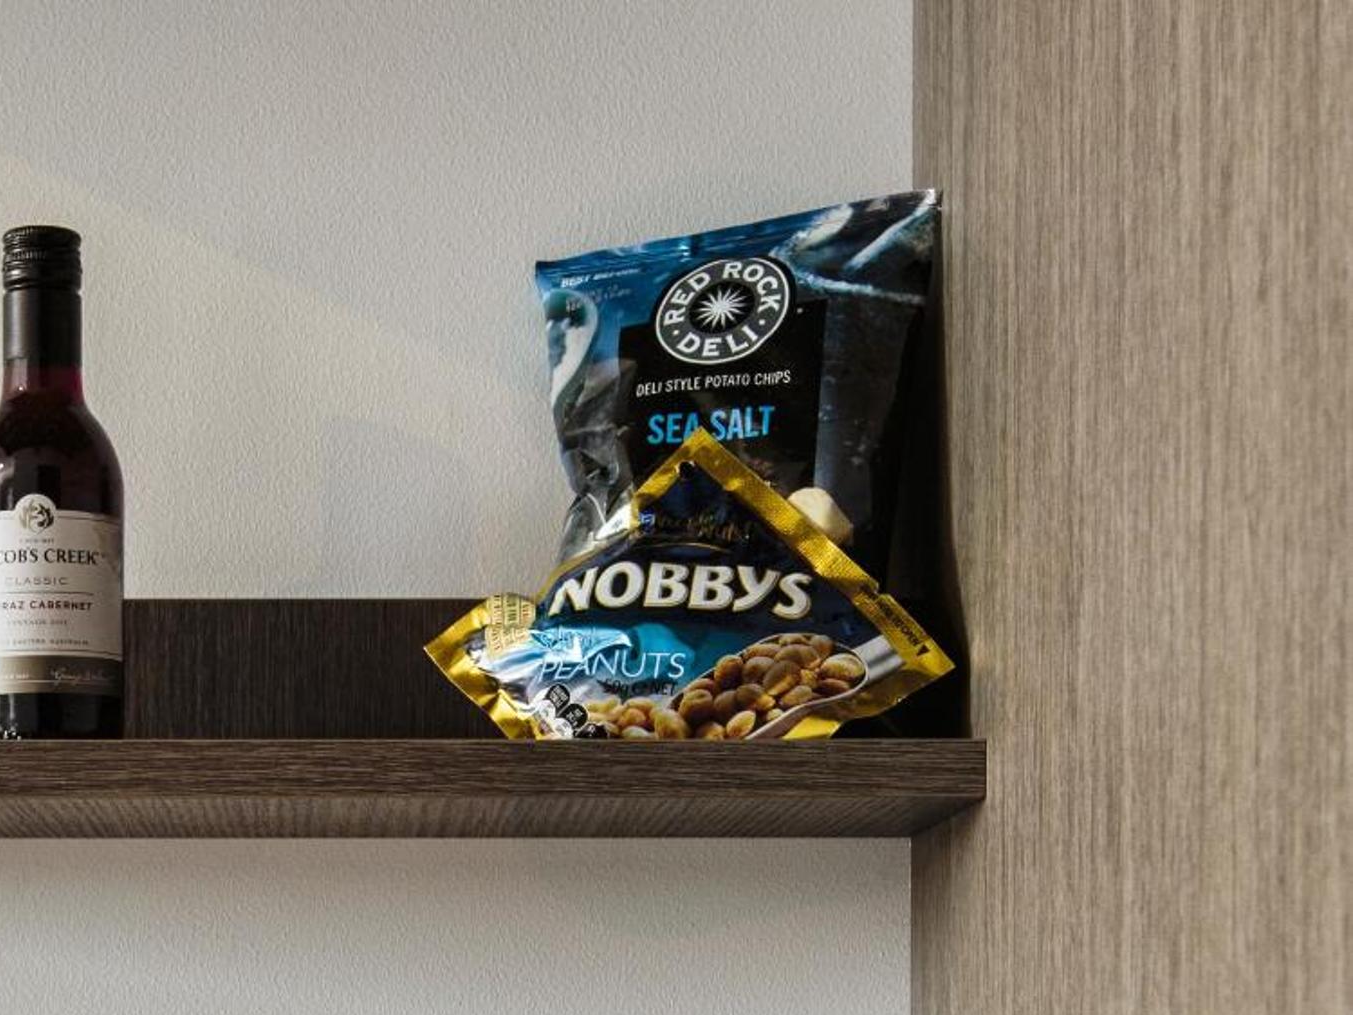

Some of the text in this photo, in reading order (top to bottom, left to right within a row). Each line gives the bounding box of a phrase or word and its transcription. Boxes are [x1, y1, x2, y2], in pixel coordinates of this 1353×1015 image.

[664, 261, 781, 325] RED ROCK
[676, 325, 758, 356] DELI
[636, 369, 792, 397] DELI STYLE POTATO CHIPS
[647, 405, 775, 444] SEA SALT
[44, 548, 98, 566] CREEK
[5, 576, 69, 587] CLASSIC
[549, 560, 813, 620] NOBBYS
[29, 600, 94, 611] CABERNET
[538, 649, 687, 684] PEANUTS
